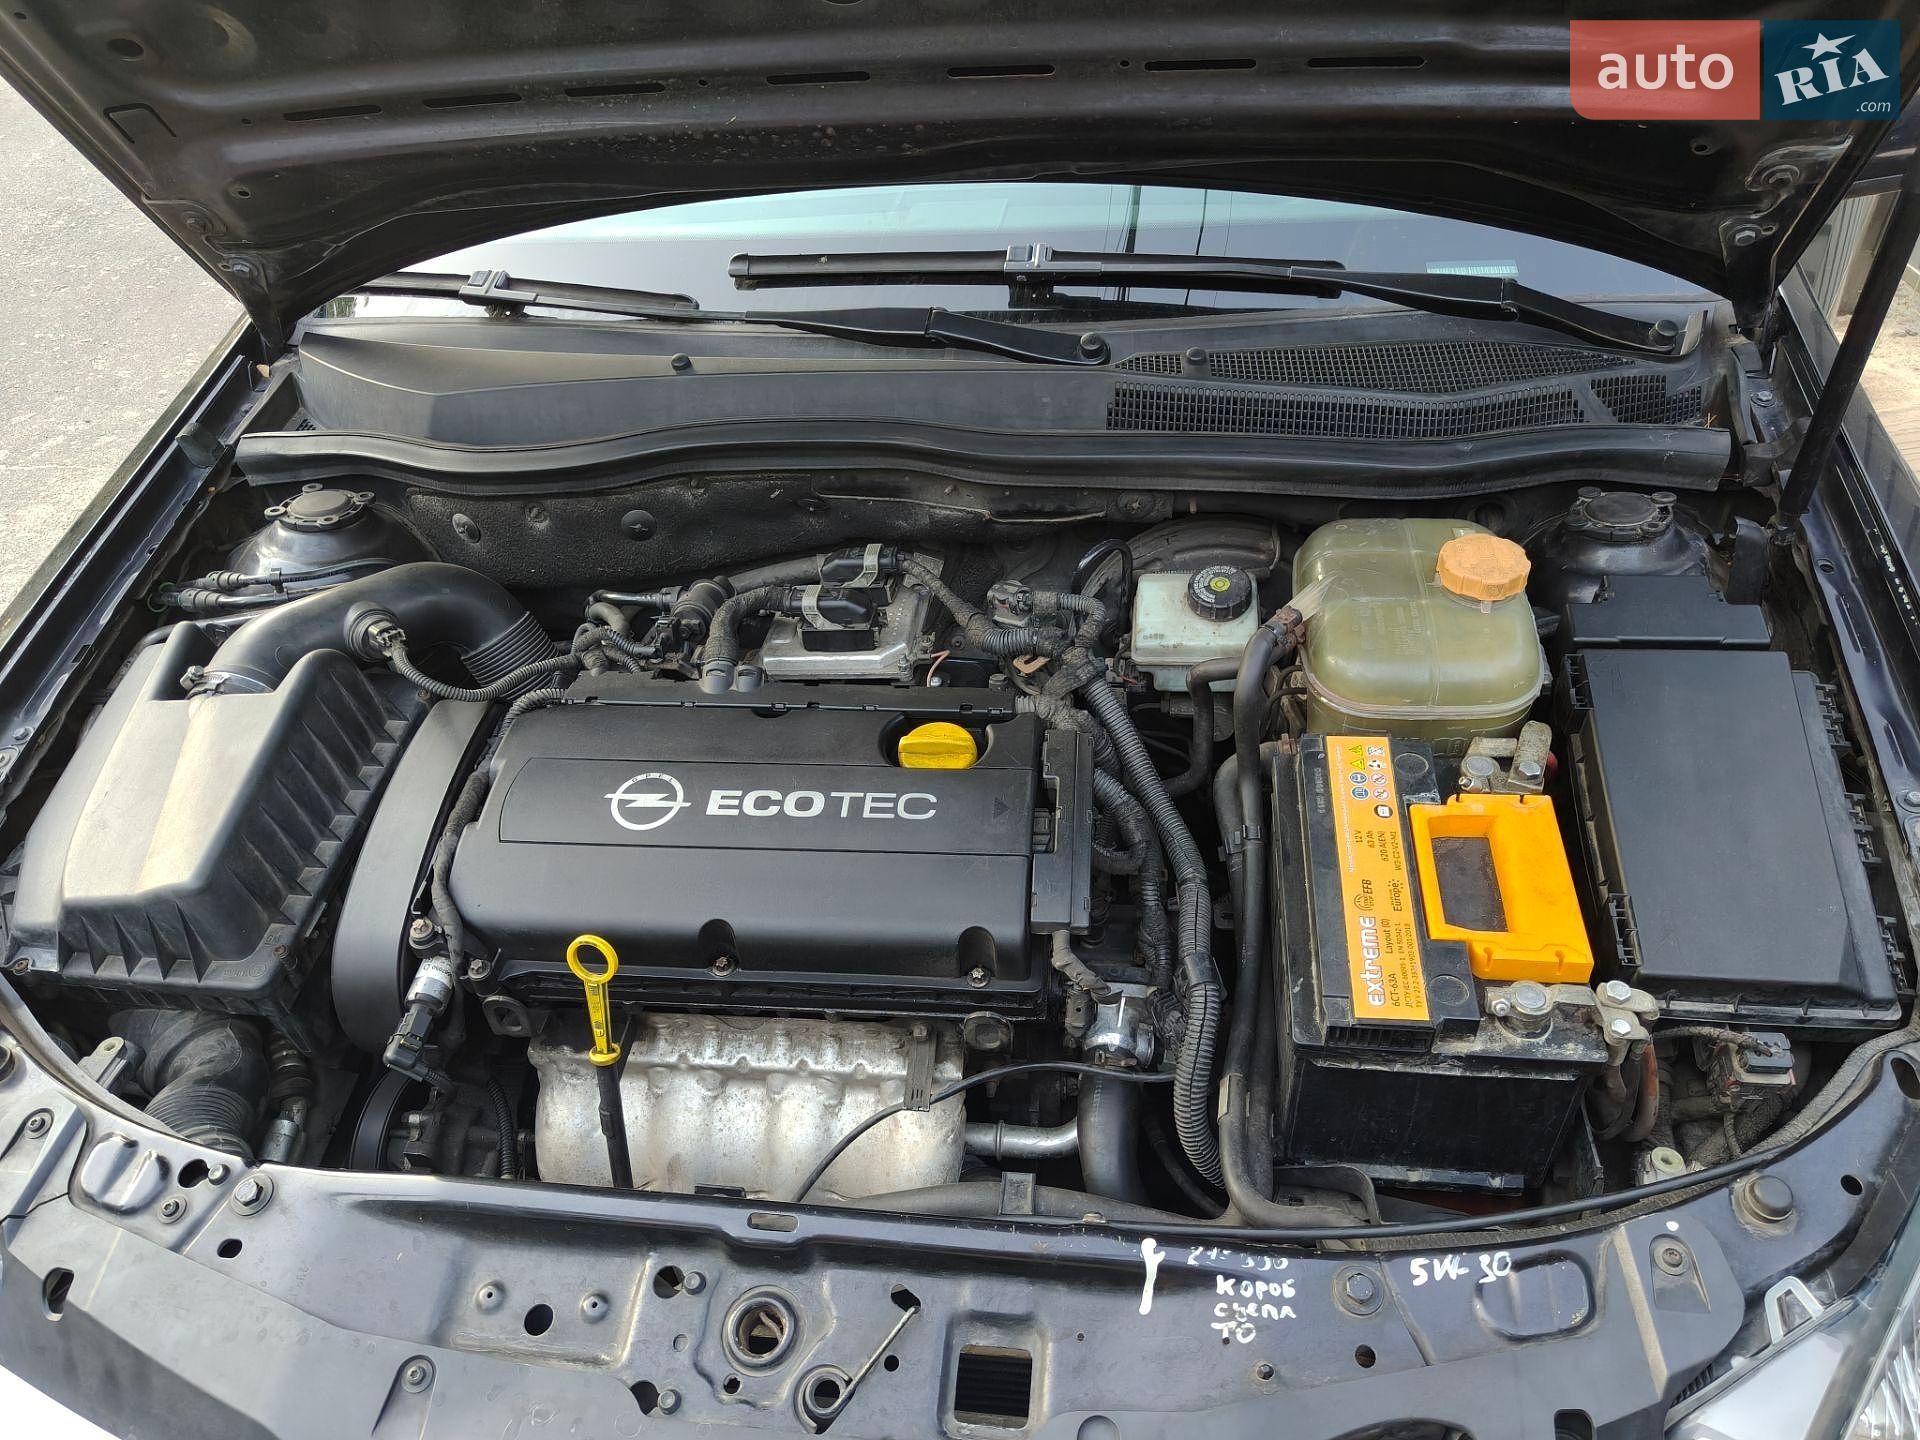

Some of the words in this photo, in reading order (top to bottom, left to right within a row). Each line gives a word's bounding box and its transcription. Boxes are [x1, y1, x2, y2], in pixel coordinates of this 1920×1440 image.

[705, 790, 938, 820] ECOTEC
[1361, 879, 1373, 894] EFB
[1384, 928, 1394, 954] Layout
